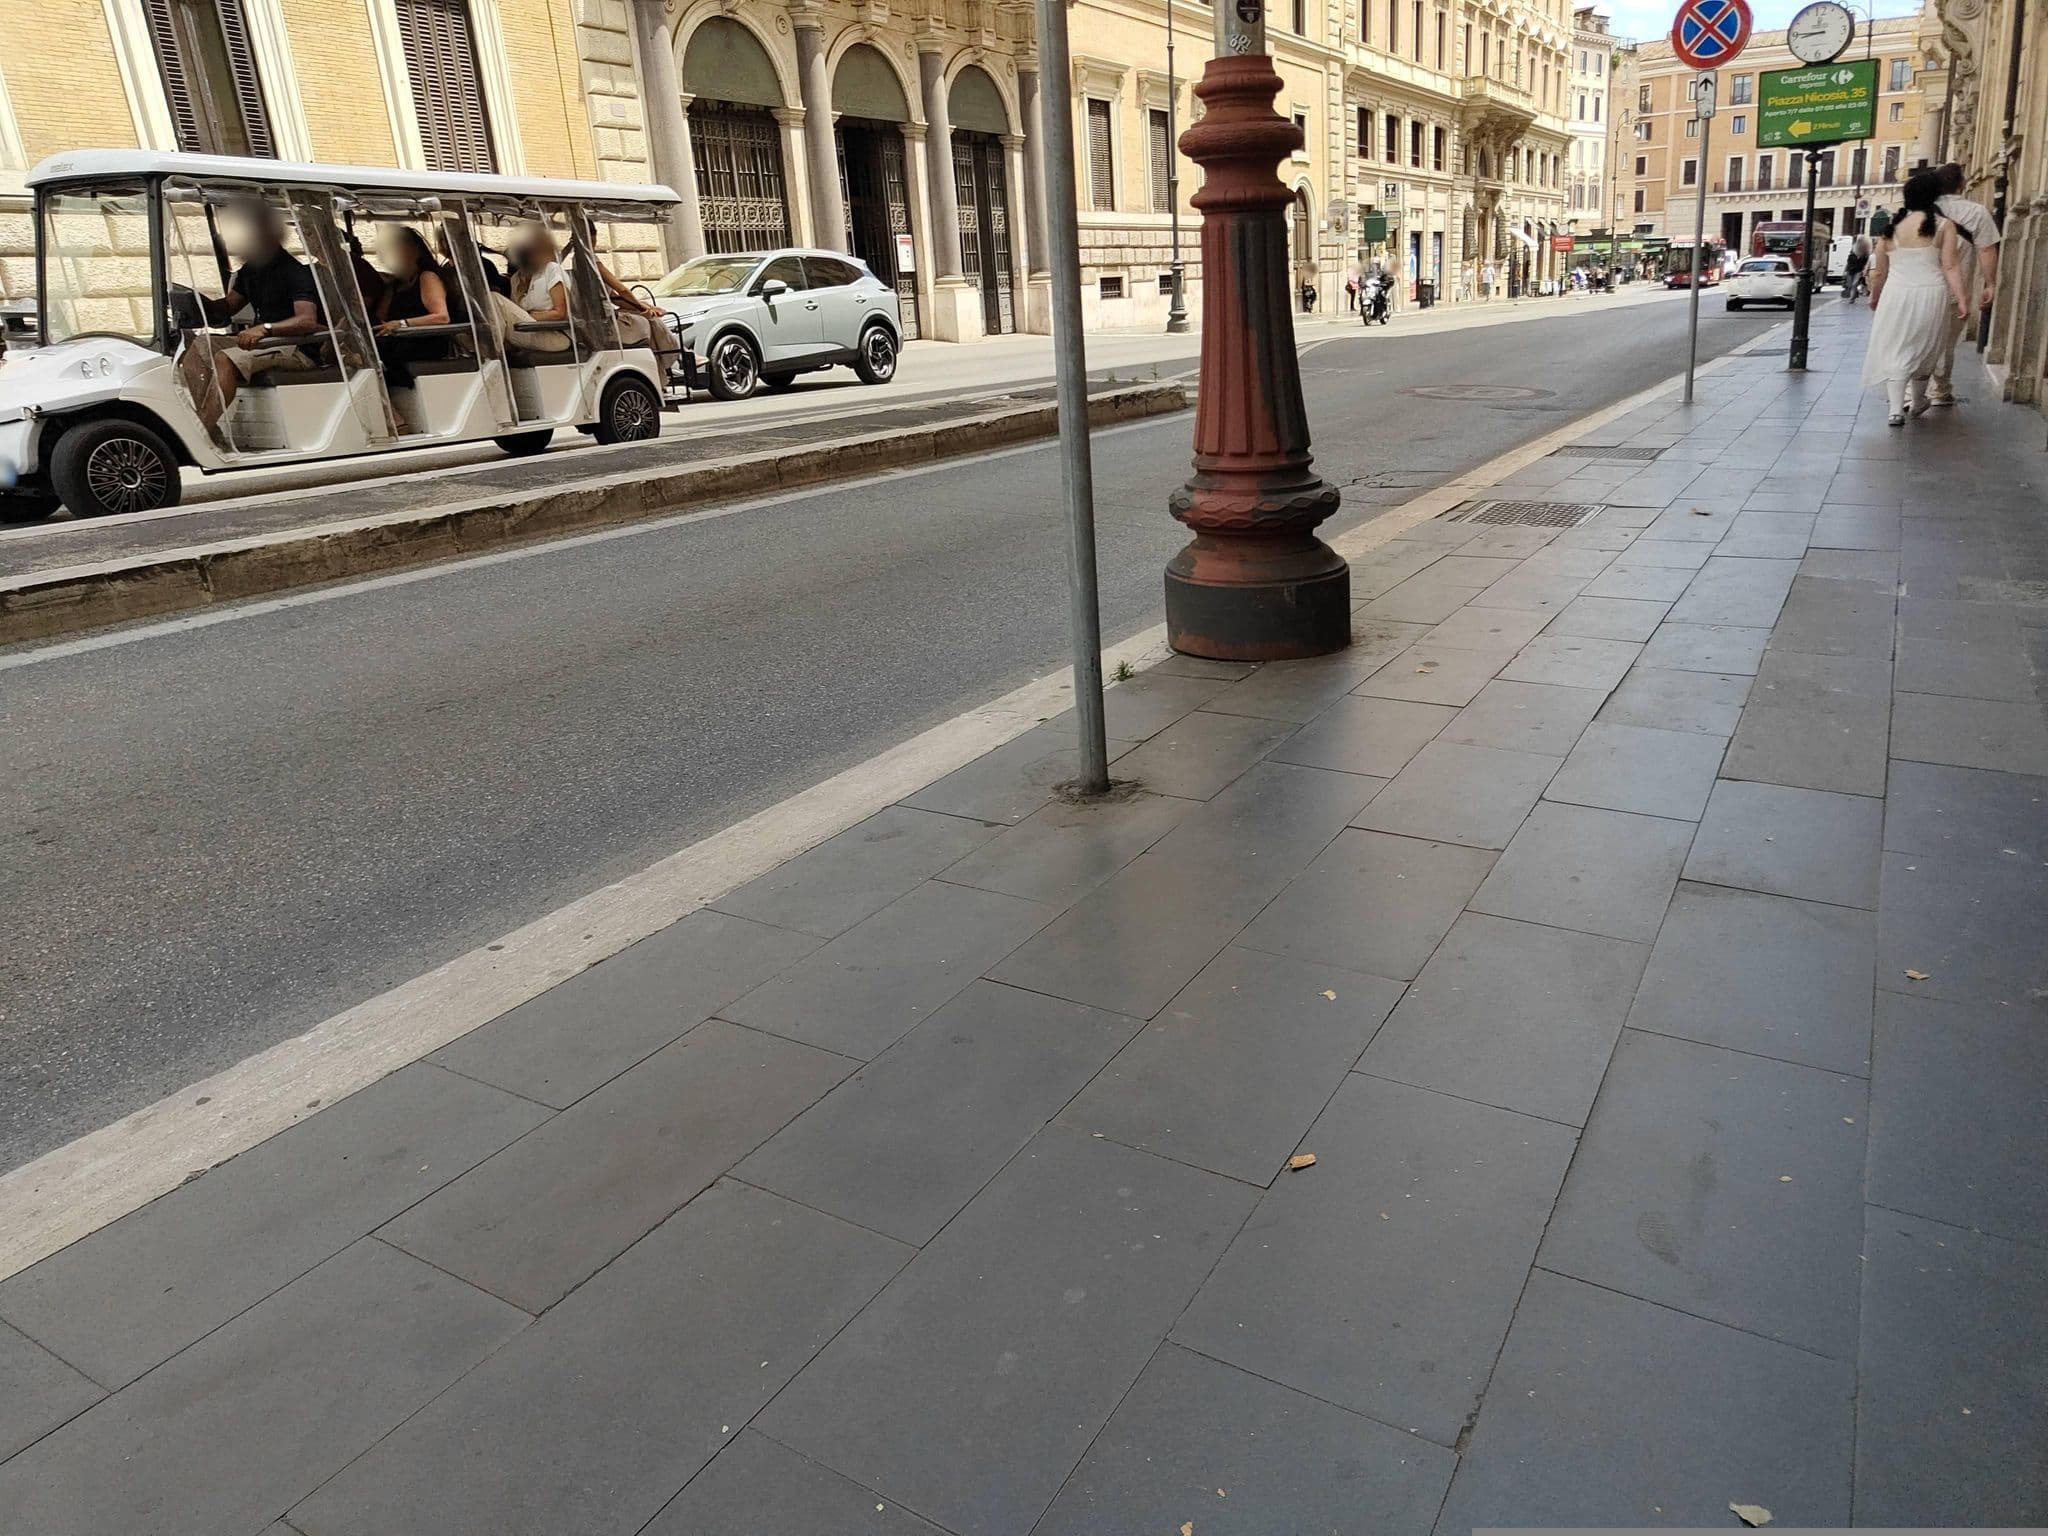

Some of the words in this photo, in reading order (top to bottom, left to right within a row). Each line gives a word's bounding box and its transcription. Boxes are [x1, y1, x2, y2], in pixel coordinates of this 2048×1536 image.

[1815, 6, 1827, 16] 12
[1814, 50, 1821, 59] 6
[1780, 72, 1828, 85] Carrefour
[1767, 95, 1803, 107] Piazza
[1851, 87, 1867, 98] 35
[1764, 110, 1787, 118] Aperto
